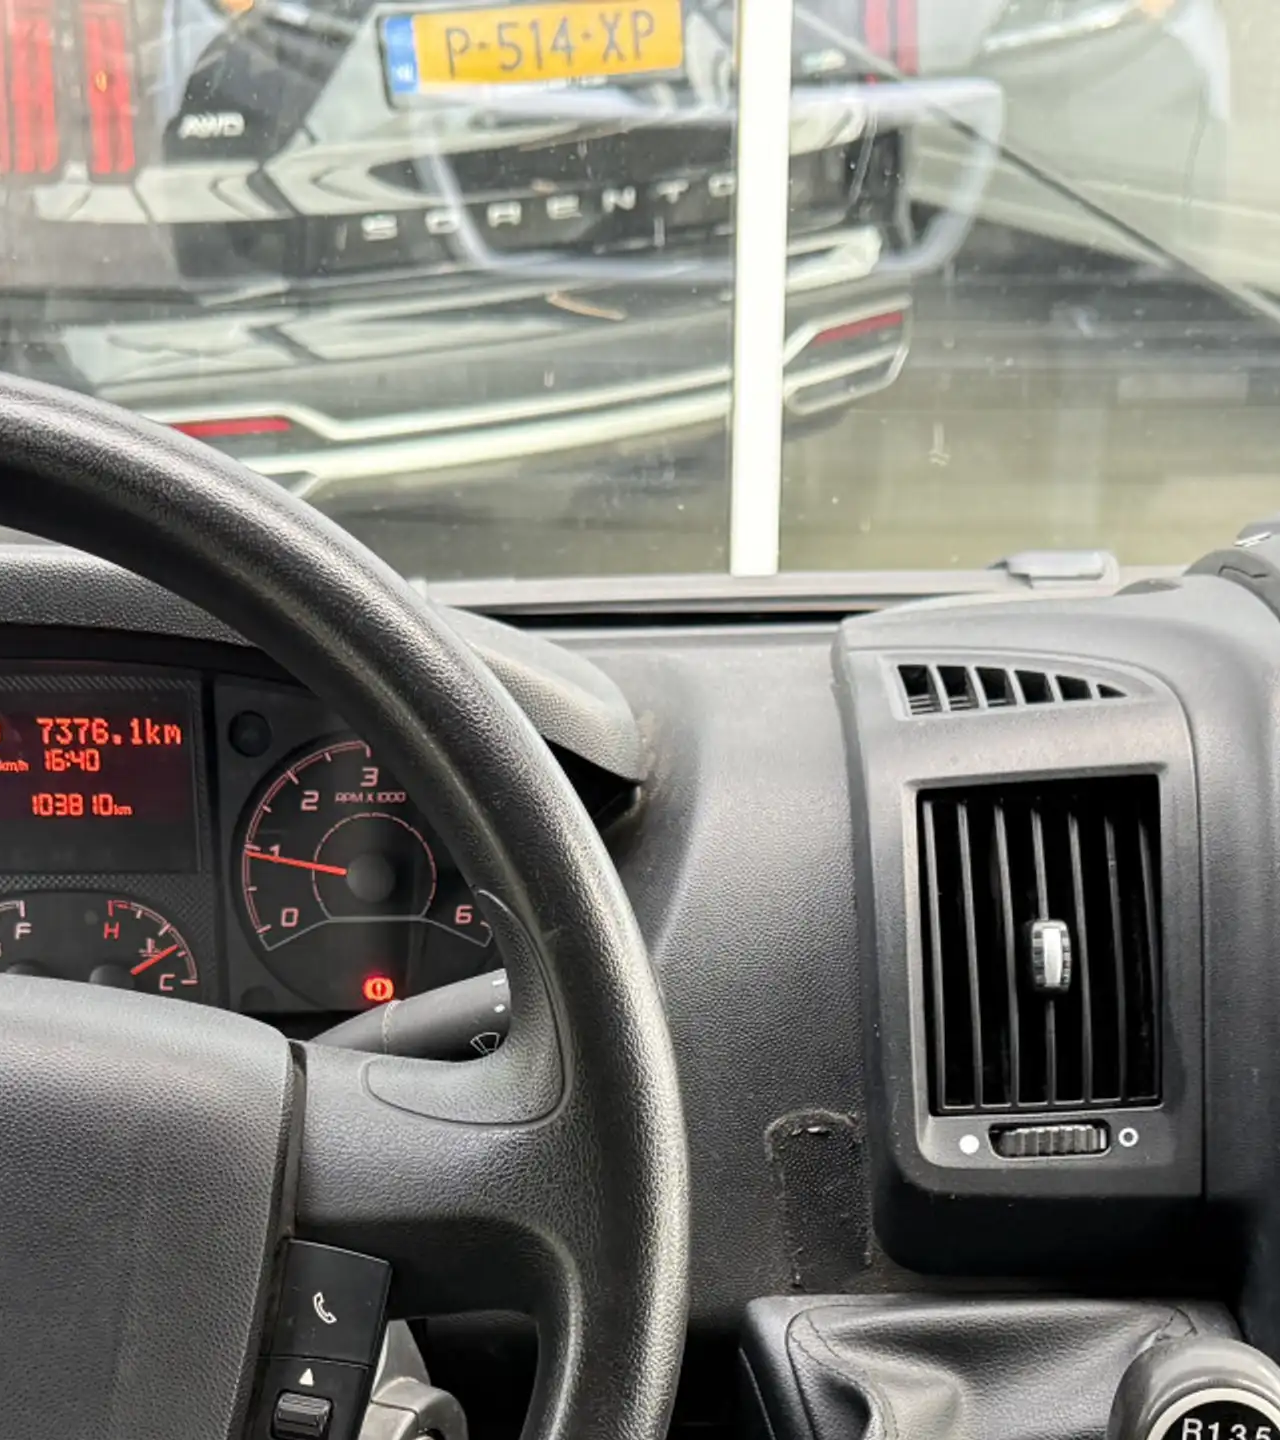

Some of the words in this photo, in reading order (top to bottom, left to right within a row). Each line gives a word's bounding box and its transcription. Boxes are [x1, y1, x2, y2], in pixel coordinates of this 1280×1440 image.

[444, 10, 655, 80] P-514-XP
[178, 111, 245, 139] AWD
[361, 173, 738, 242] SORENTO
[44, 749, 101, 772] 16:40
[360, 767, 379, 787] 3
[300, 790, 319, 811] 2
[334, 791, 363, 803] RPM
[376, 791, 407, 803] 1000
[281, 907, 299, 928] 0
[454, 905, 473, 924] 6
[14, 922, 32, 940] F
[103, 921, 121, 940] H
[159, 973, 175, 991] C
